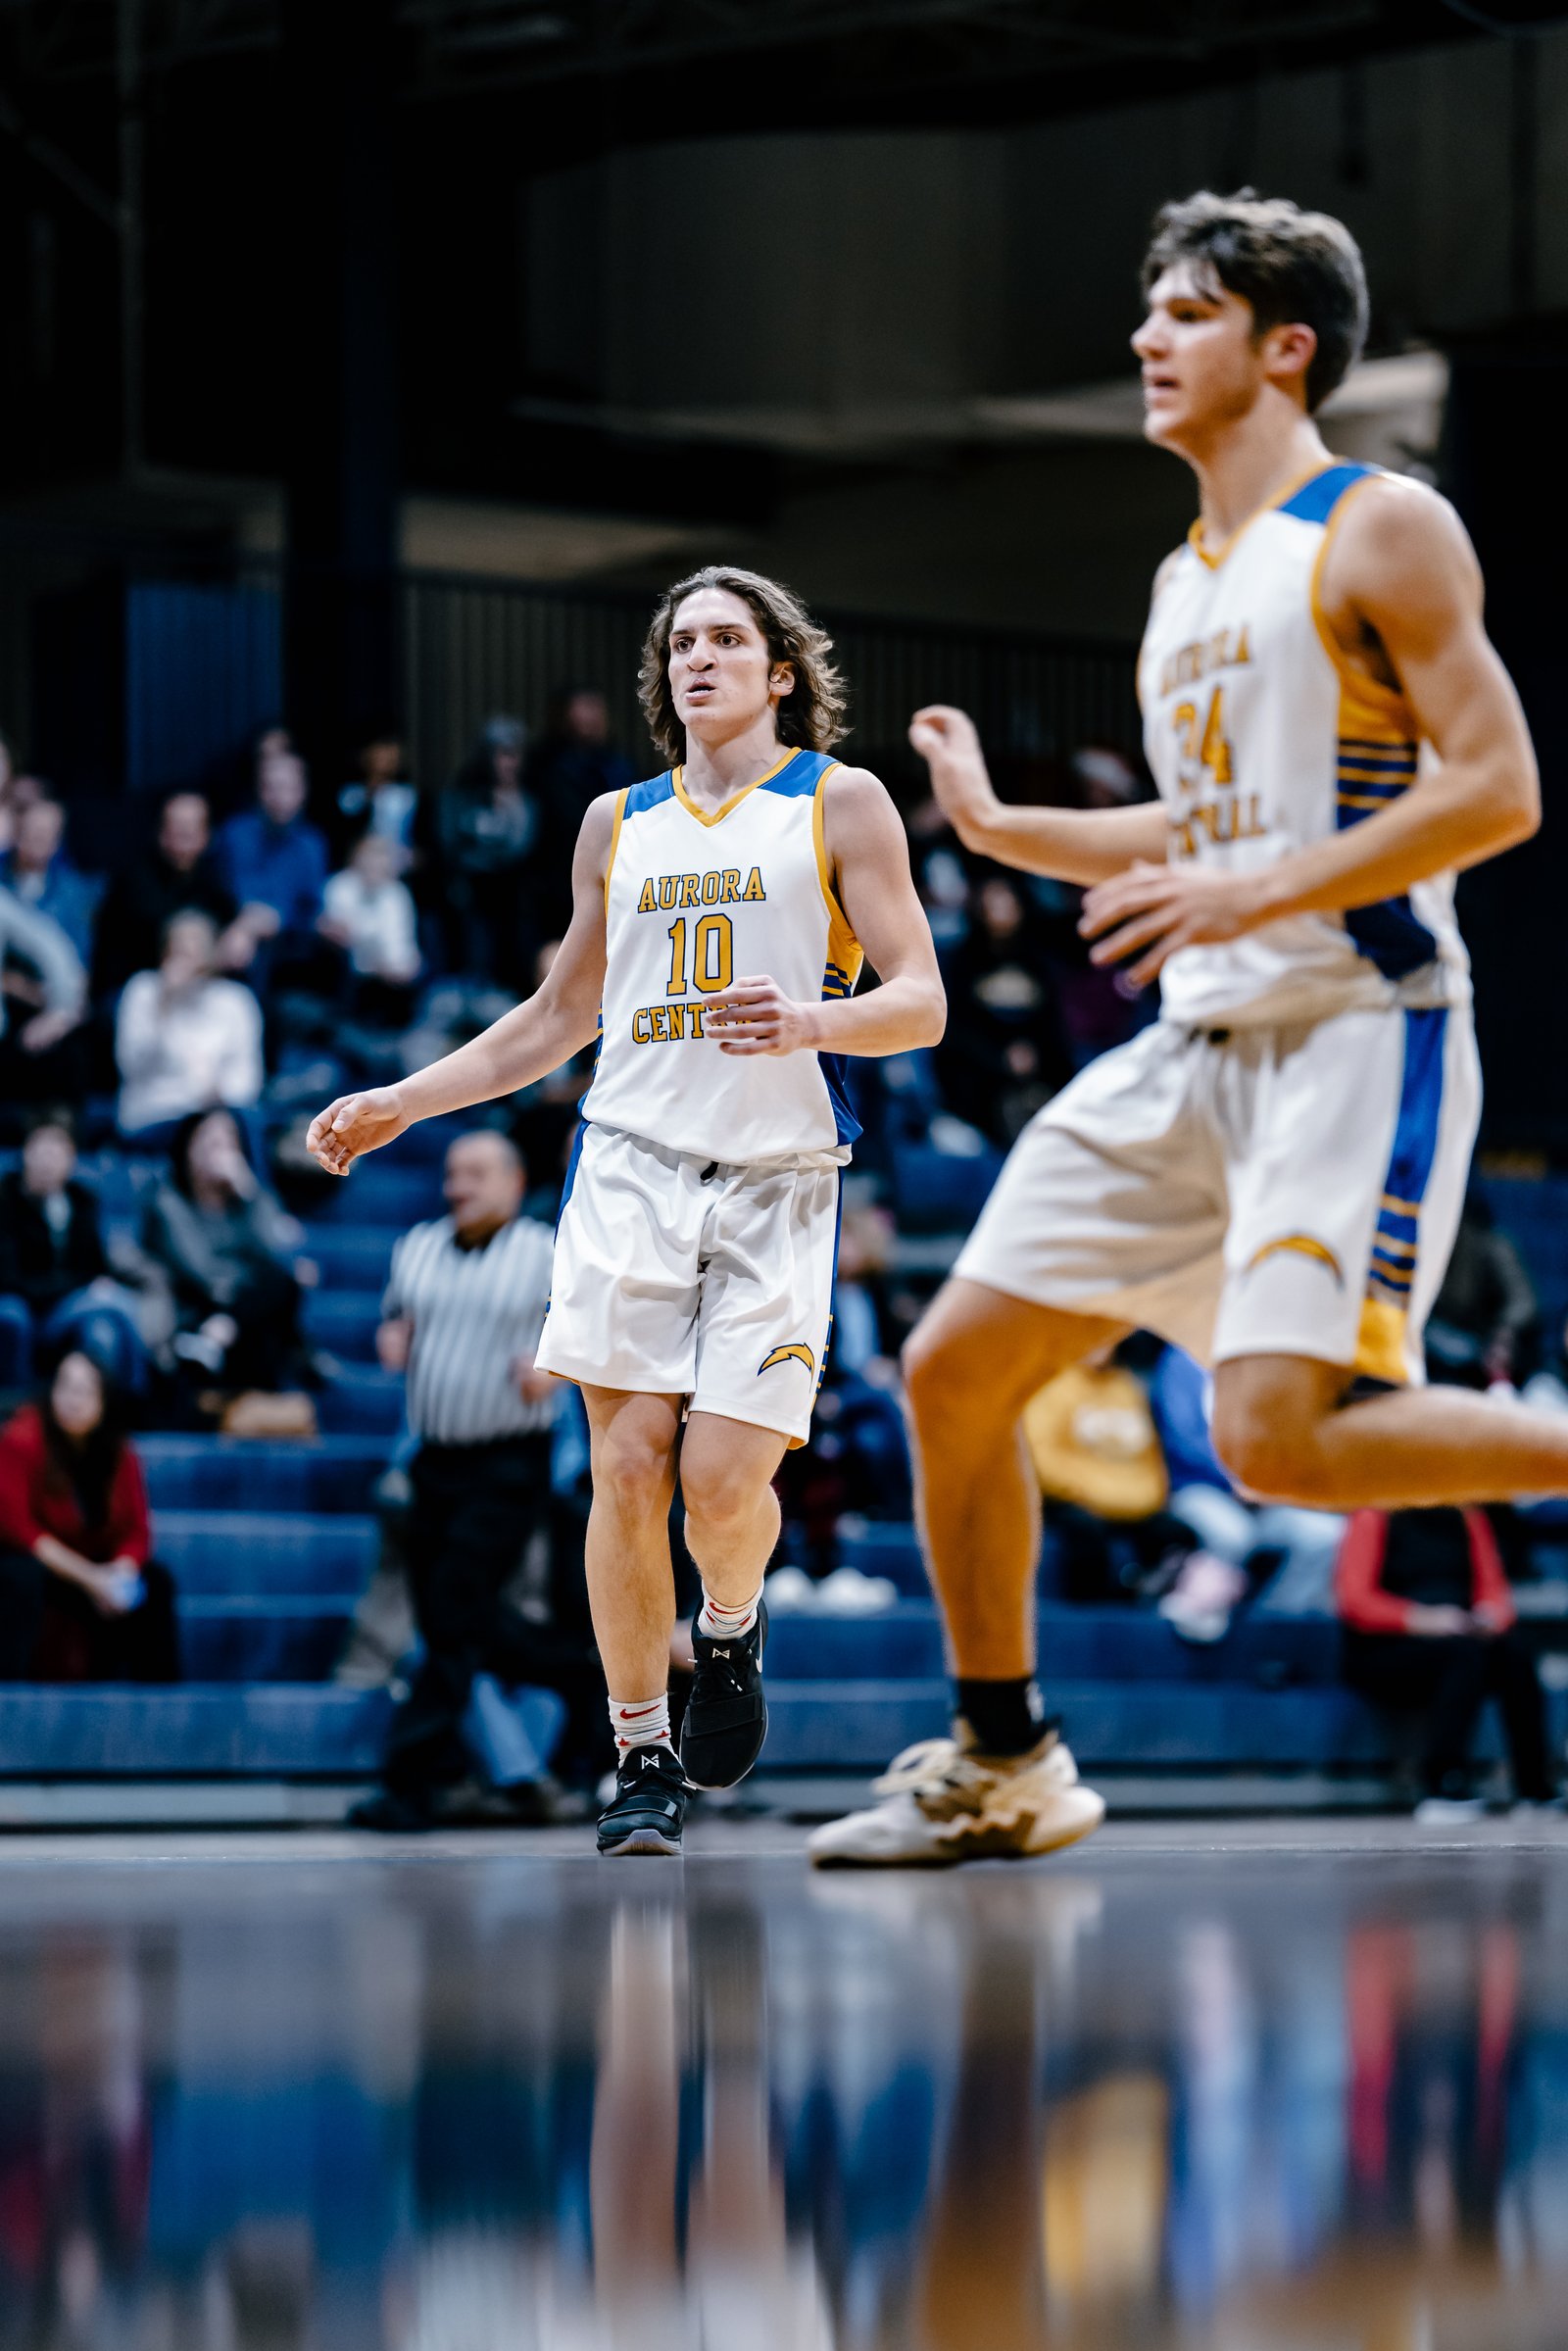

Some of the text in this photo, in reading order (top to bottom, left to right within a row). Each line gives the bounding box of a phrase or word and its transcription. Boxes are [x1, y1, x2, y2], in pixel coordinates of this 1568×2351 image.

[638, 866, 766, 913] AURORA
[666, 913, 734, 997] 10
[632, 1001, 769, 1044] CENT
